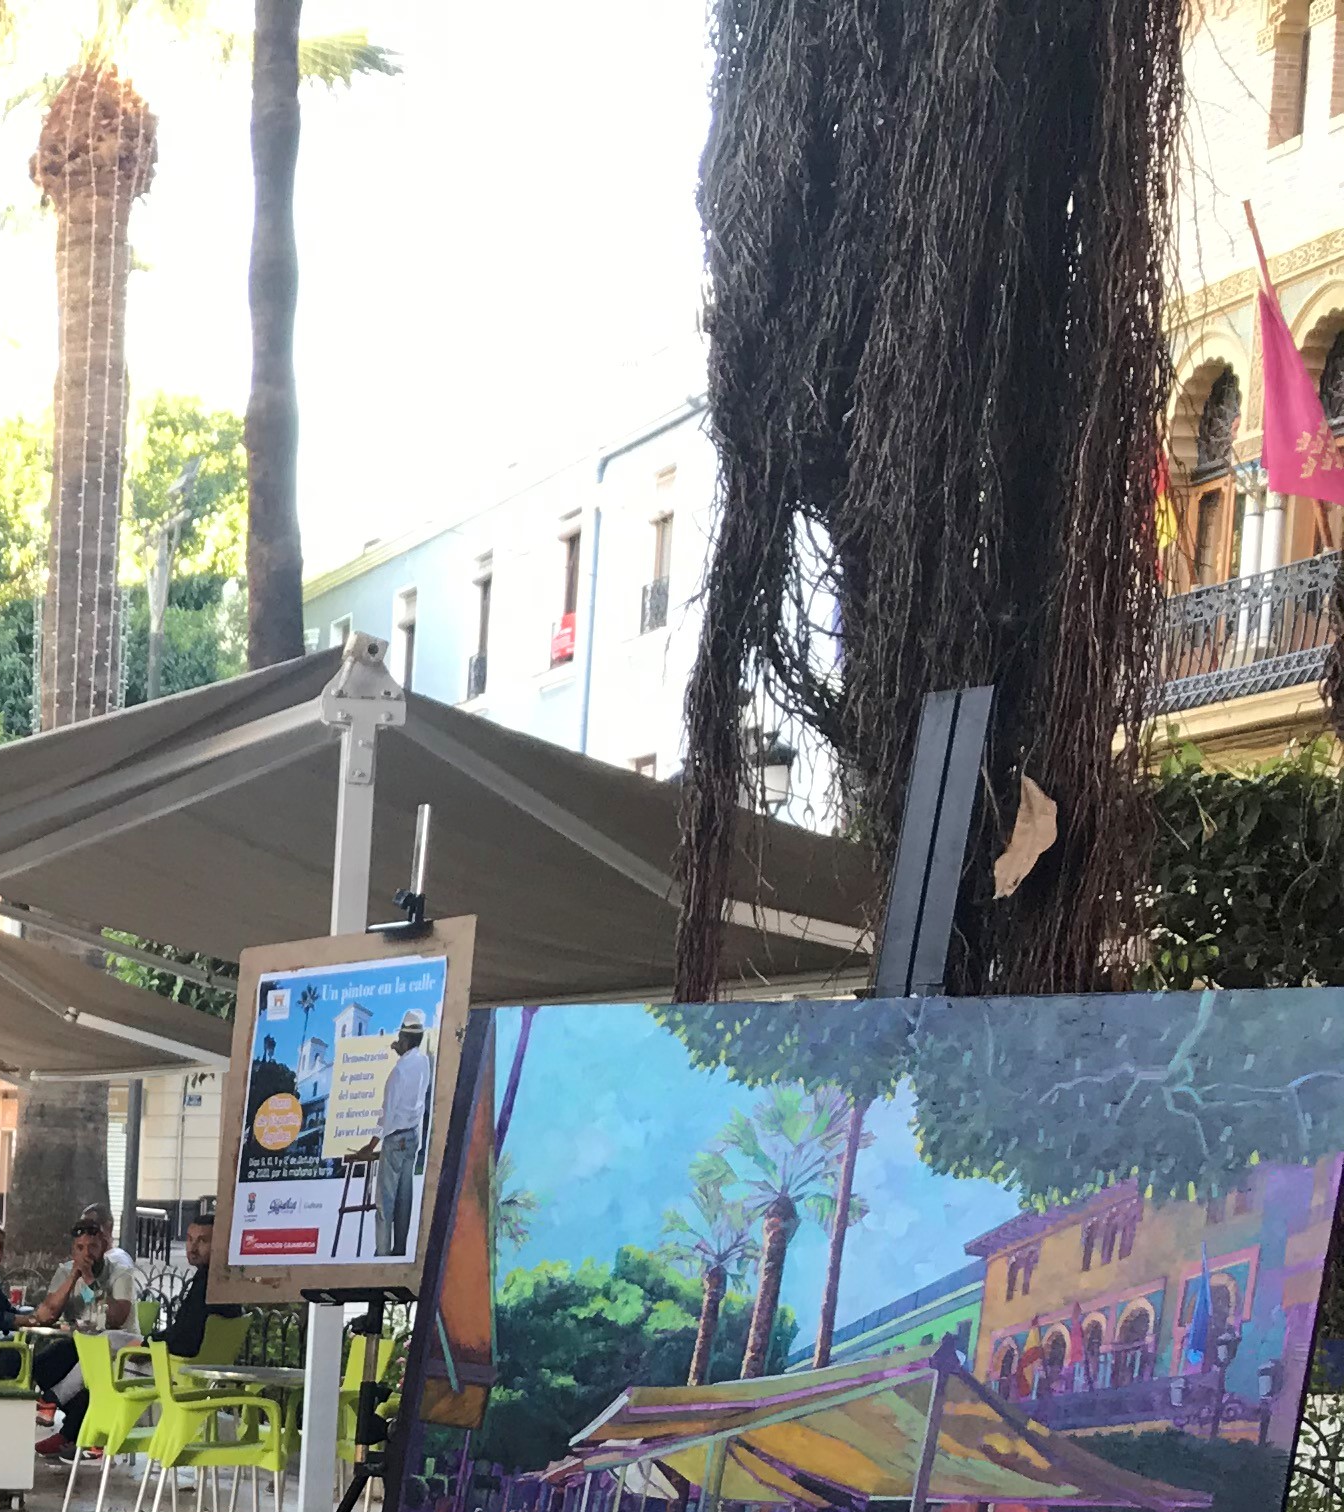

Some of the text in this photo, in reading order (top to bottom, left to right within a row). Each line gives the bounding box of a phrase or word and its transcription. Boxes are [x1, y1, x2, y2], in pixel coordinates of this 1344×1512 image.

[322, 972, 436, 1005] Un pintor en la calle
